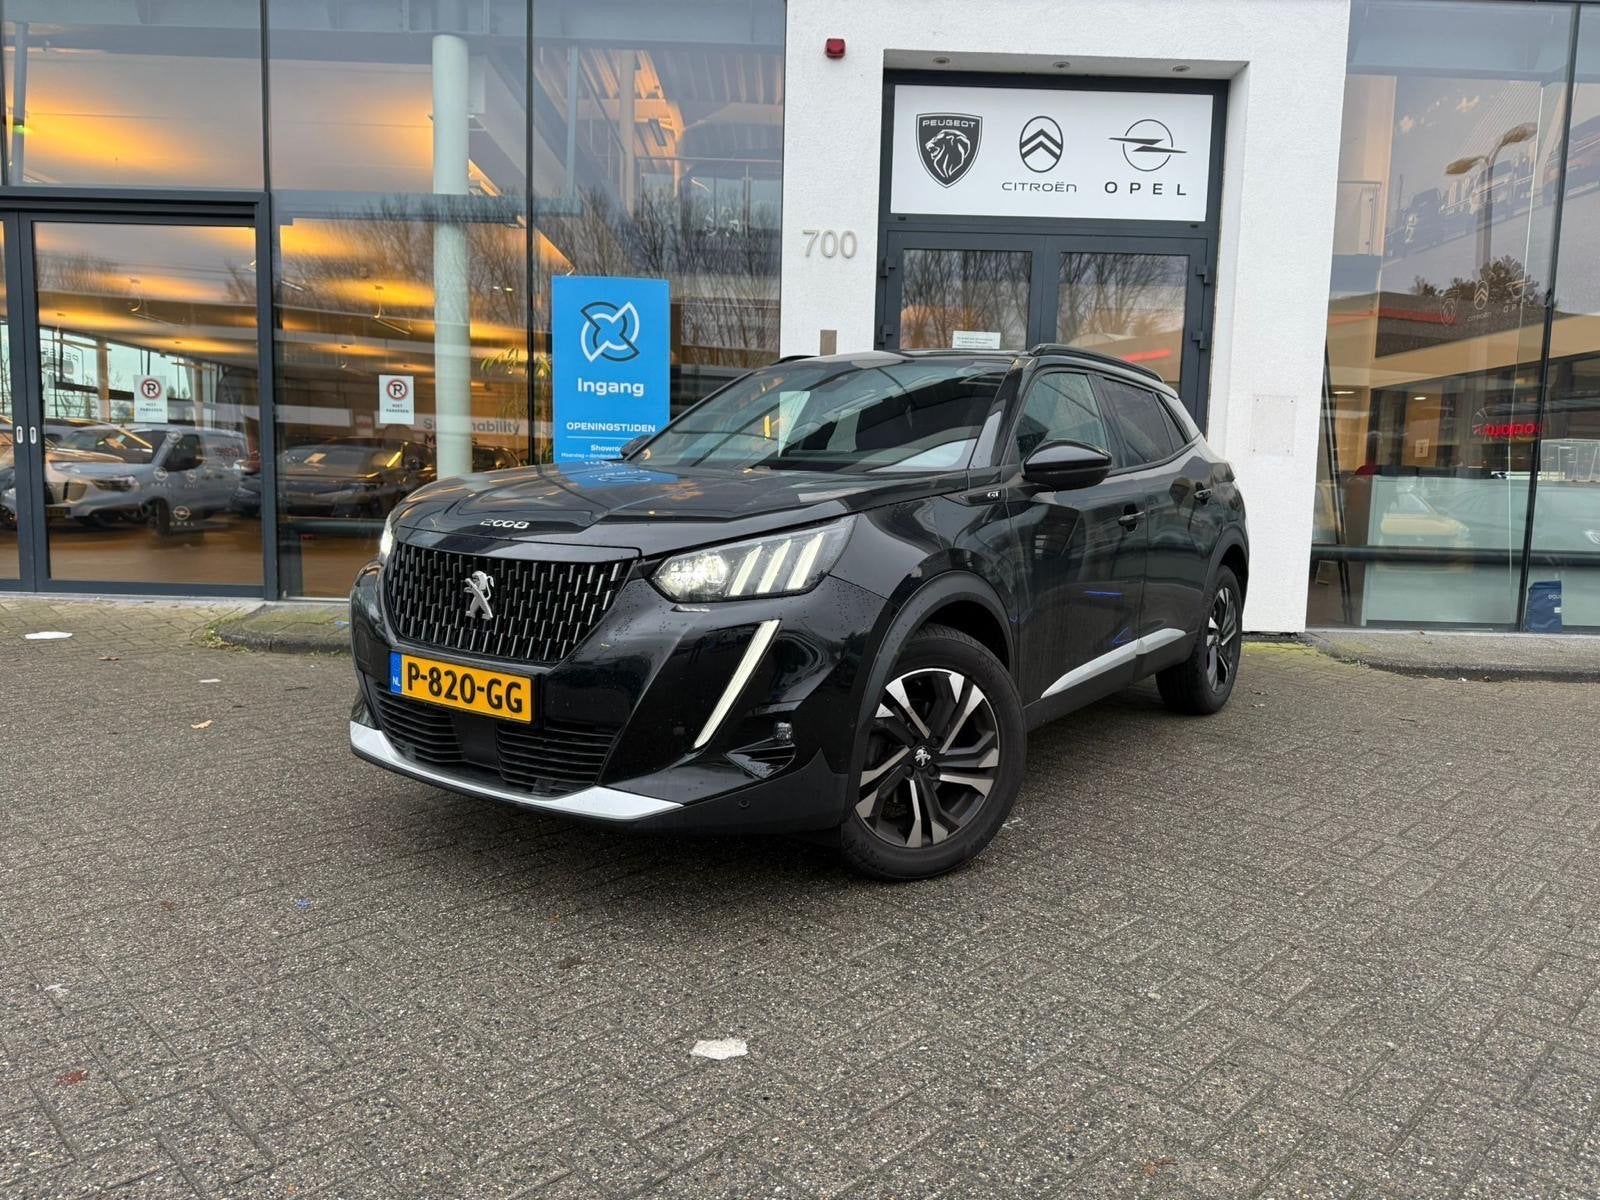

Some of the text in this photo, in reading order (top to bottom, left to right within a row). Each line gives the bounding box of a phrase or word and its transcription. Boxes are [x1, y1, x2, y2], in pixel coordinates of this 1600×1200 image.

[922, 118, 977, 129] PEUGEOT
[1104, 181, 1187, 196] OPEL
[802, 229, 858, 260] 700
[577, 377, 645, 397] Ingang
[566, 421, 657, 433] OPENINGSTIJDEN
[590, 444, 621, 452] Showro
[480, 518, 530, 529] 2008
[392, 675, 401, 687] NL
[407, 661, 523, 713] P-820-GG
